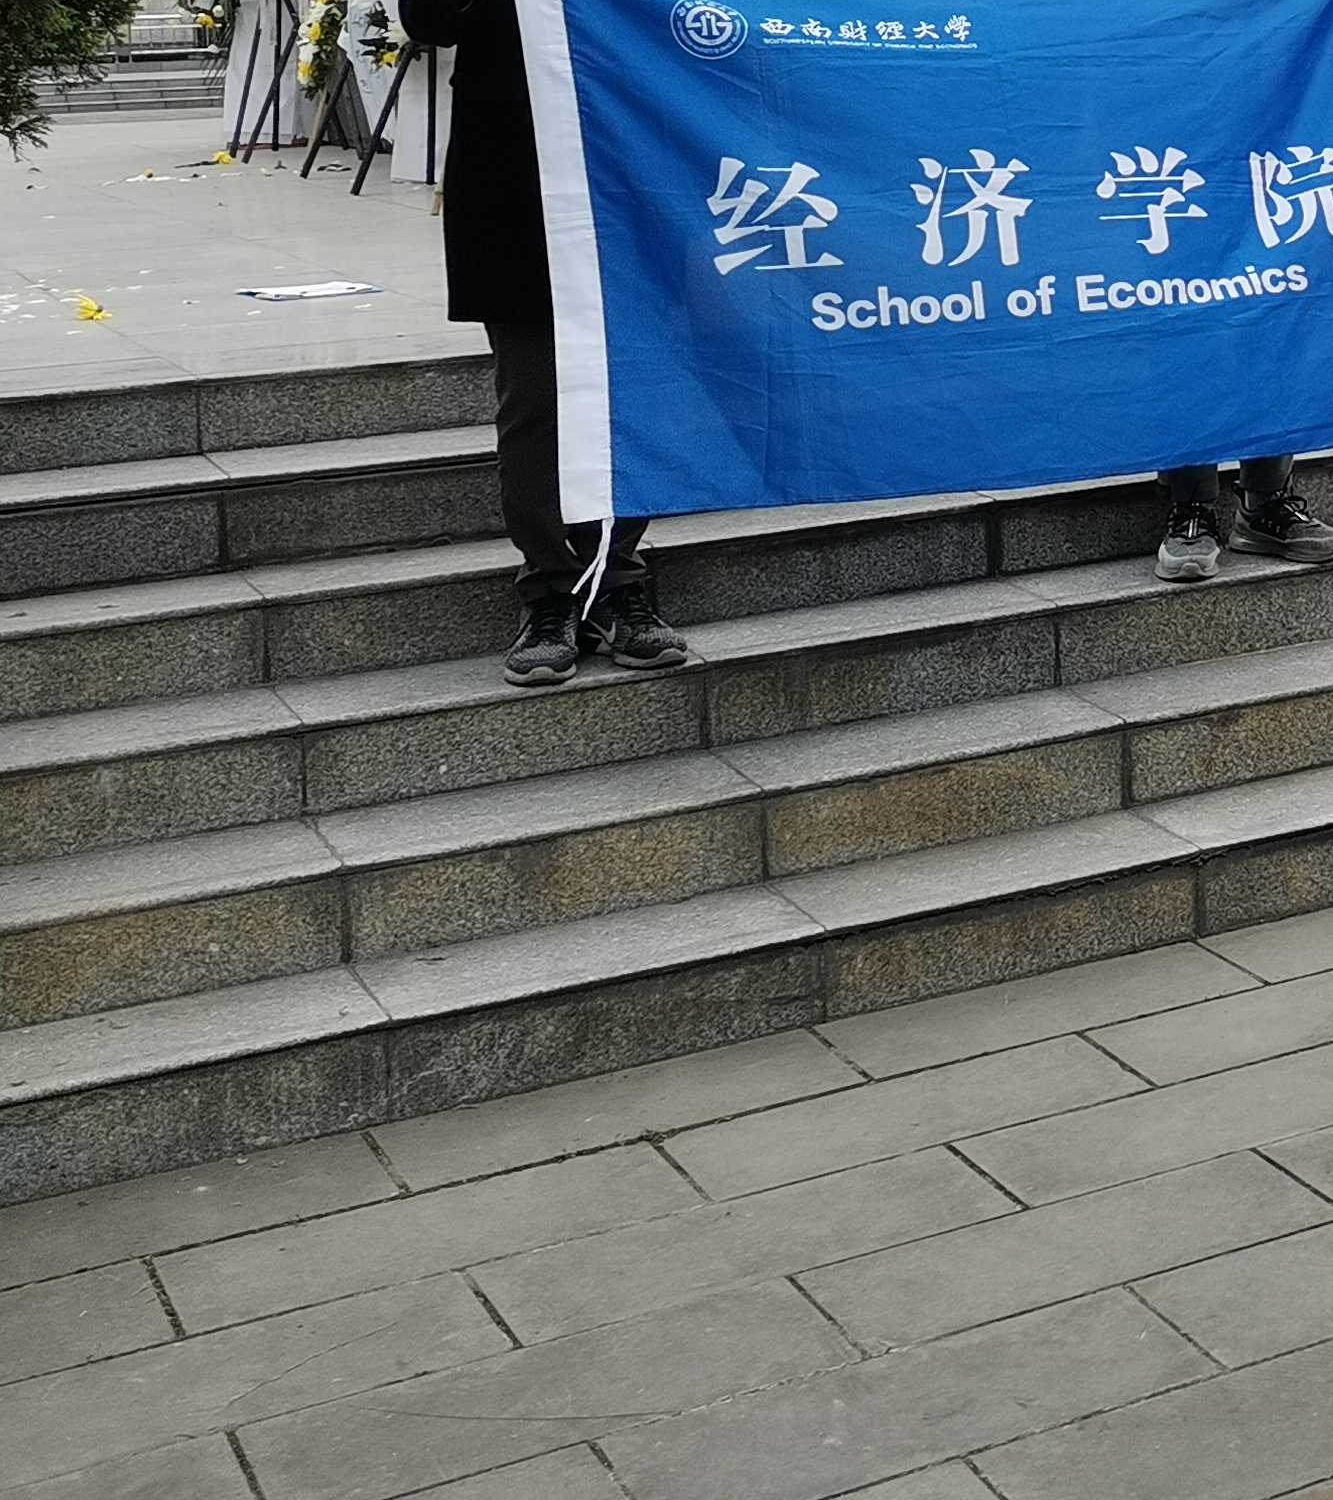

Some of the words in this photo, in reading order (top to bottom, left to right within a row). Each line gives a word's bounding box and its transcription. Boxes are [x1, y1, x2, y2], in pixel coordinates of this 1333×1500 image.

[811, 280, 986, 331] School
[1006, 275, 1056, 318] of
[1075, 264, 1309, 312] Economics
